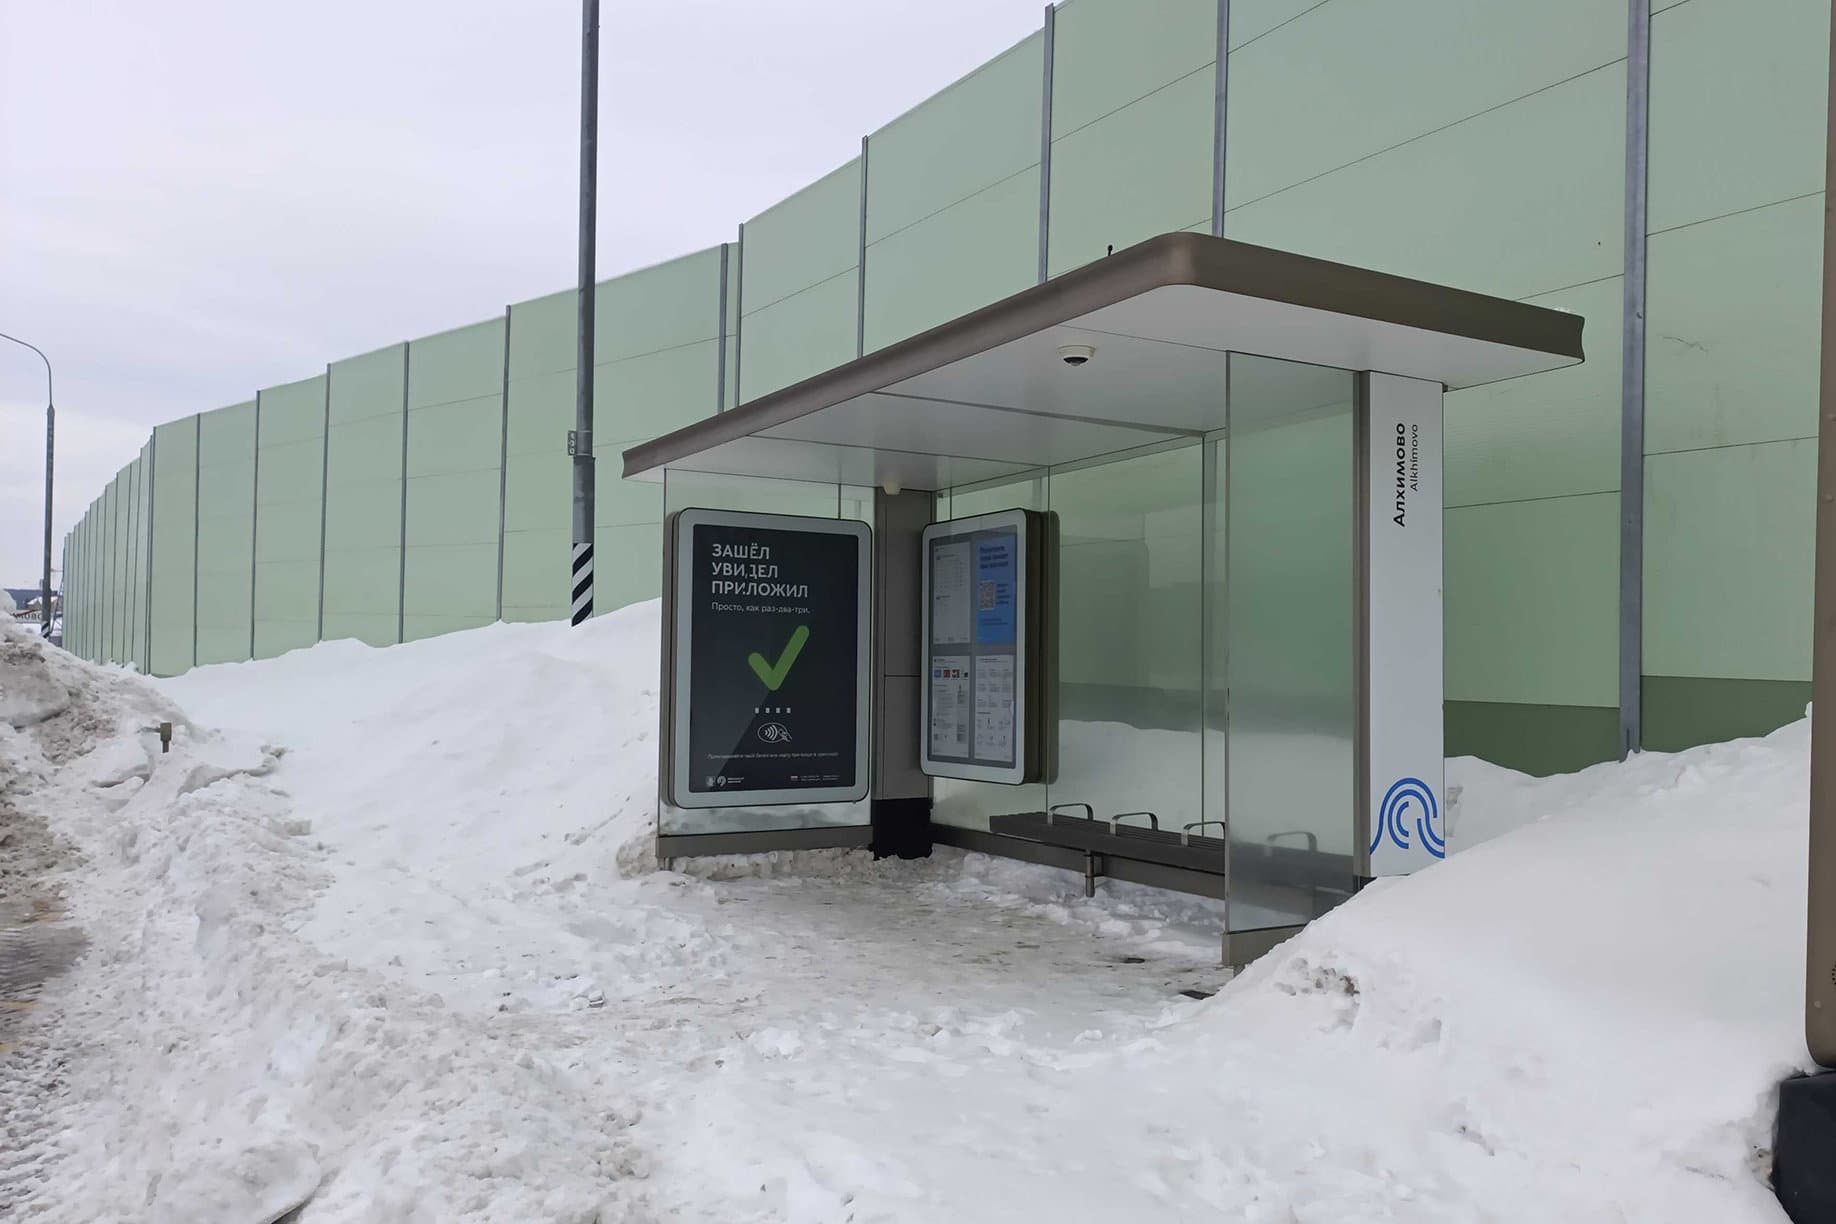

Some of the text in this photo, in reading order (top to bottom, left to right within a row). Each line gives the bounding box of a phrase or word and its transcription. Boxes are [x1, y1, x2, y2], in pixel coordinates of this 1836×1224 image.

[1410, 424, 1418, 491] Alkhimovo
[711, 543, 770, 560] ЗАШЁЛ
[711, 581, 808, 598] ПРИЛОЖИЛ
[711, 602, 744, 612] Просто,
